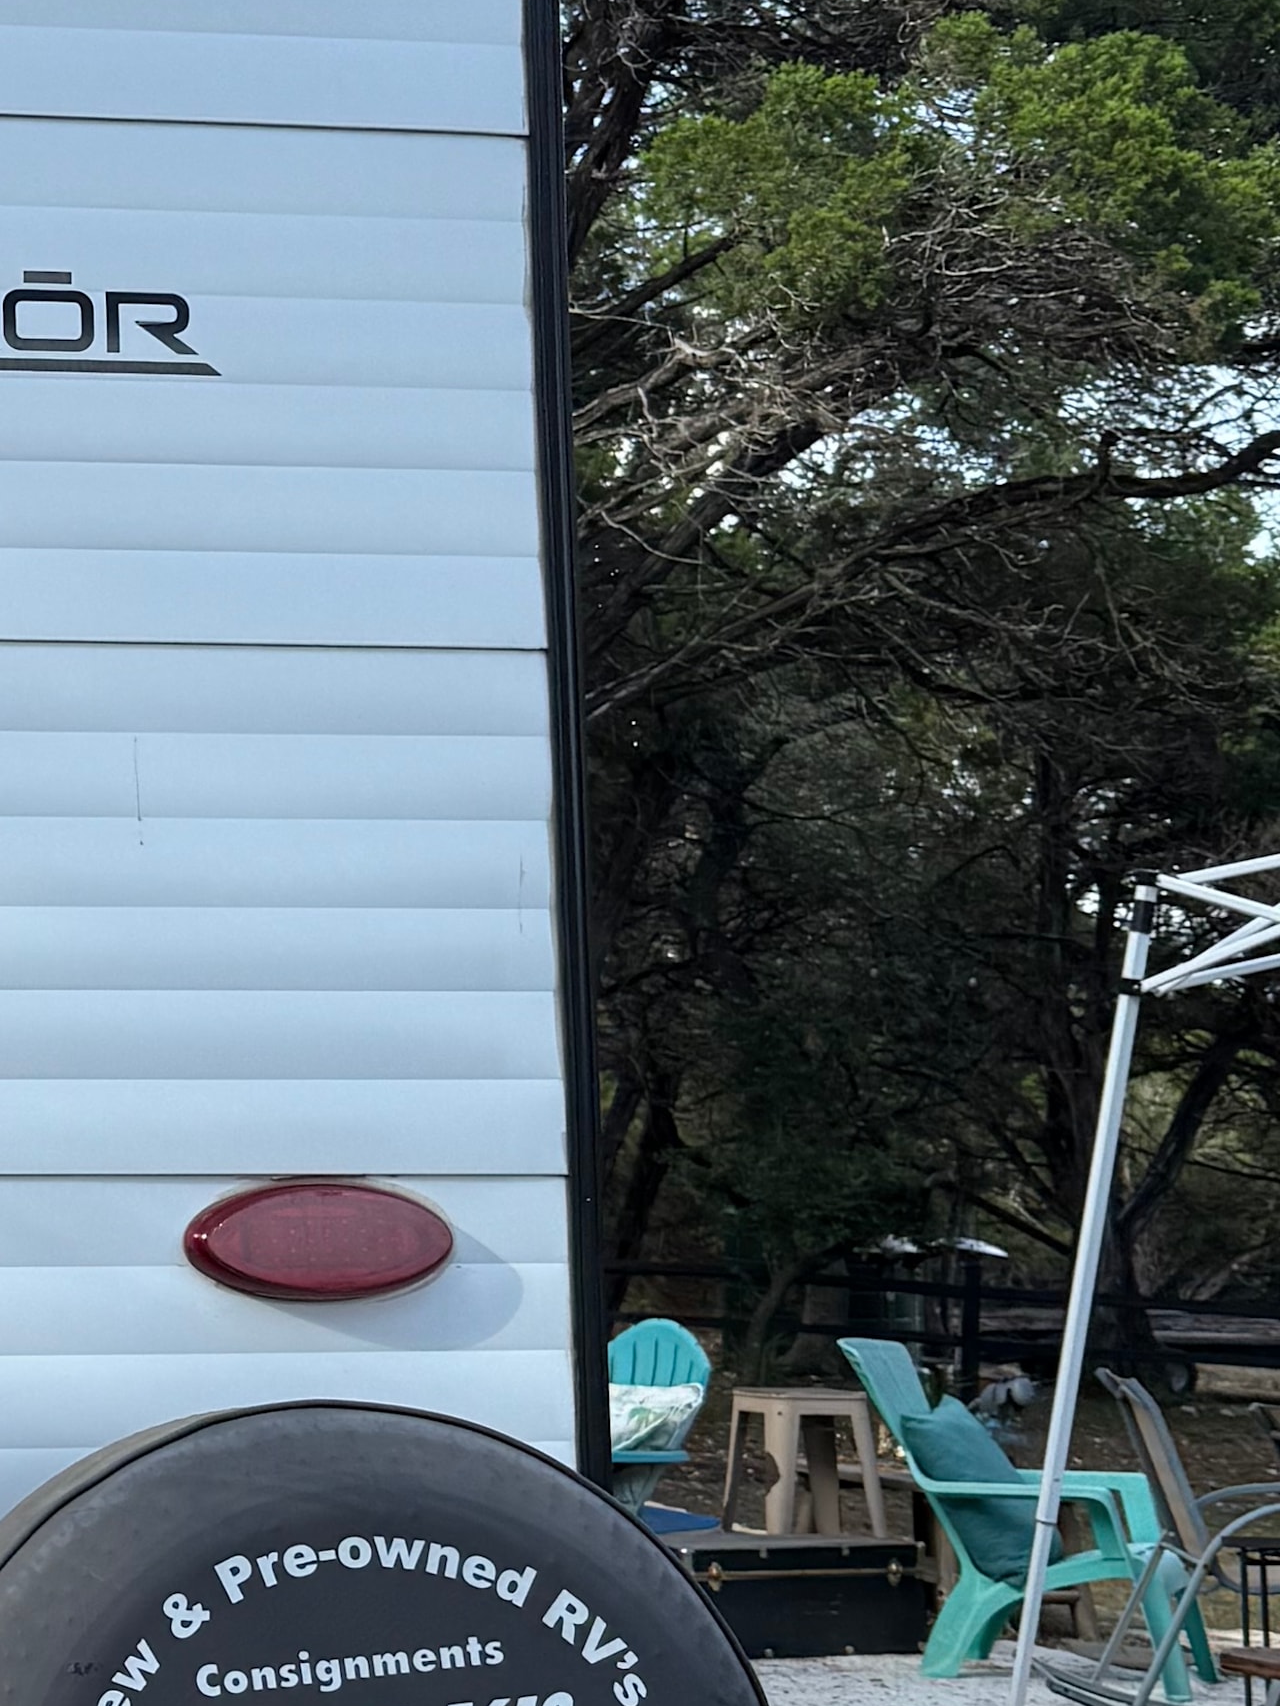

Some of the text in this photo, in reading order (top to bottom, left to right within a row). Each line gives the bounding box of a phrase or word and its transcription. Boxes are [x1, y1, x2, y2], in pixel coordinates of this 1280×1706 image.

[163, 1593, 210, 1639] &
[215, 1536, 537, 1608] Pre-owned
[196, 1636, 504, 1697] Consignments
